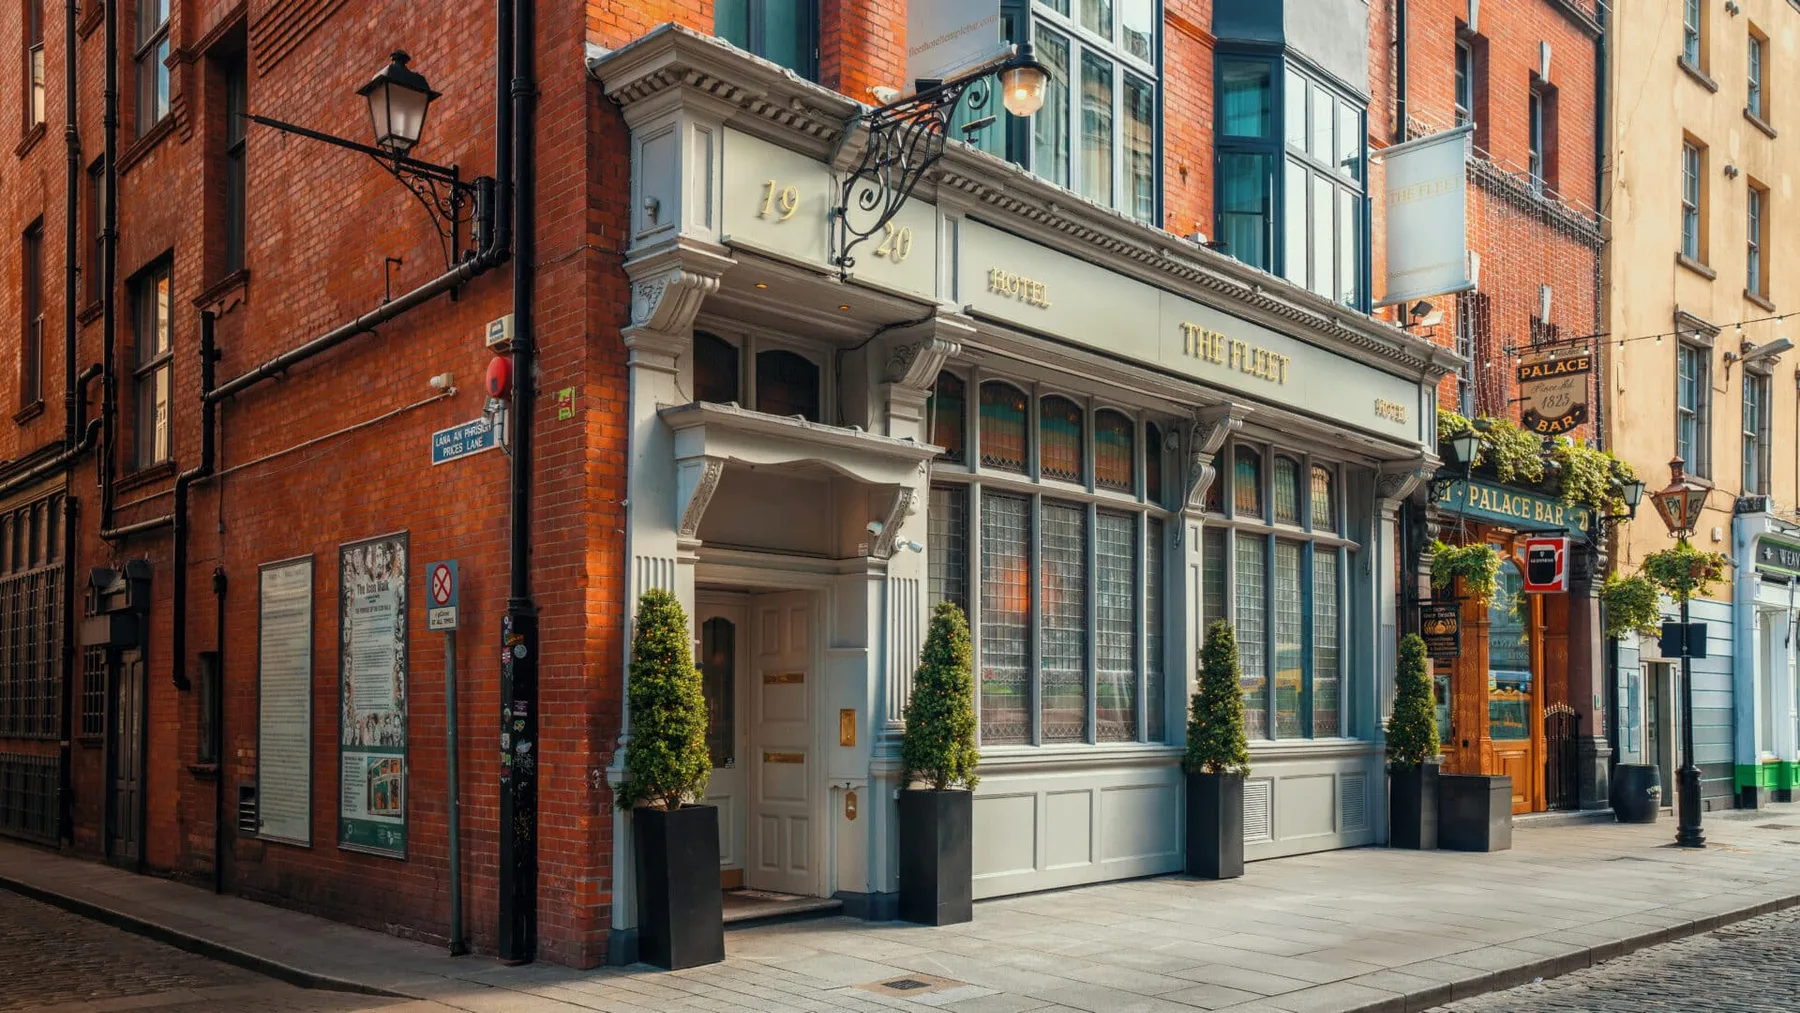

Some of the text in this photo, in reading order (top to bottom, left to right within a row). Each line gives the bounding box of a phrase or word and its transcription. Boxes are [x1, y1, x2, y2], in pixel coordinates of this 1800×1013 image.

[759, 179, 913, 261] 19 20
[988, 265, 1053, 307] HOTEL
[1181, 321, 1291, 384] THE FLEET
[1521, 357, 1590, 379] PALACE
[435, 432, 451, 448] LÁNA
[453, 428, 463, 441] AN
[1536, 415, 1576, 432] BAR
[442, 436, 484, 457] PRICES LANE
[1469, 485, 1531, 519] PALACE
[1534, 500, 1565, 526] BAR
[1578, 510, 1590, 532] 21
